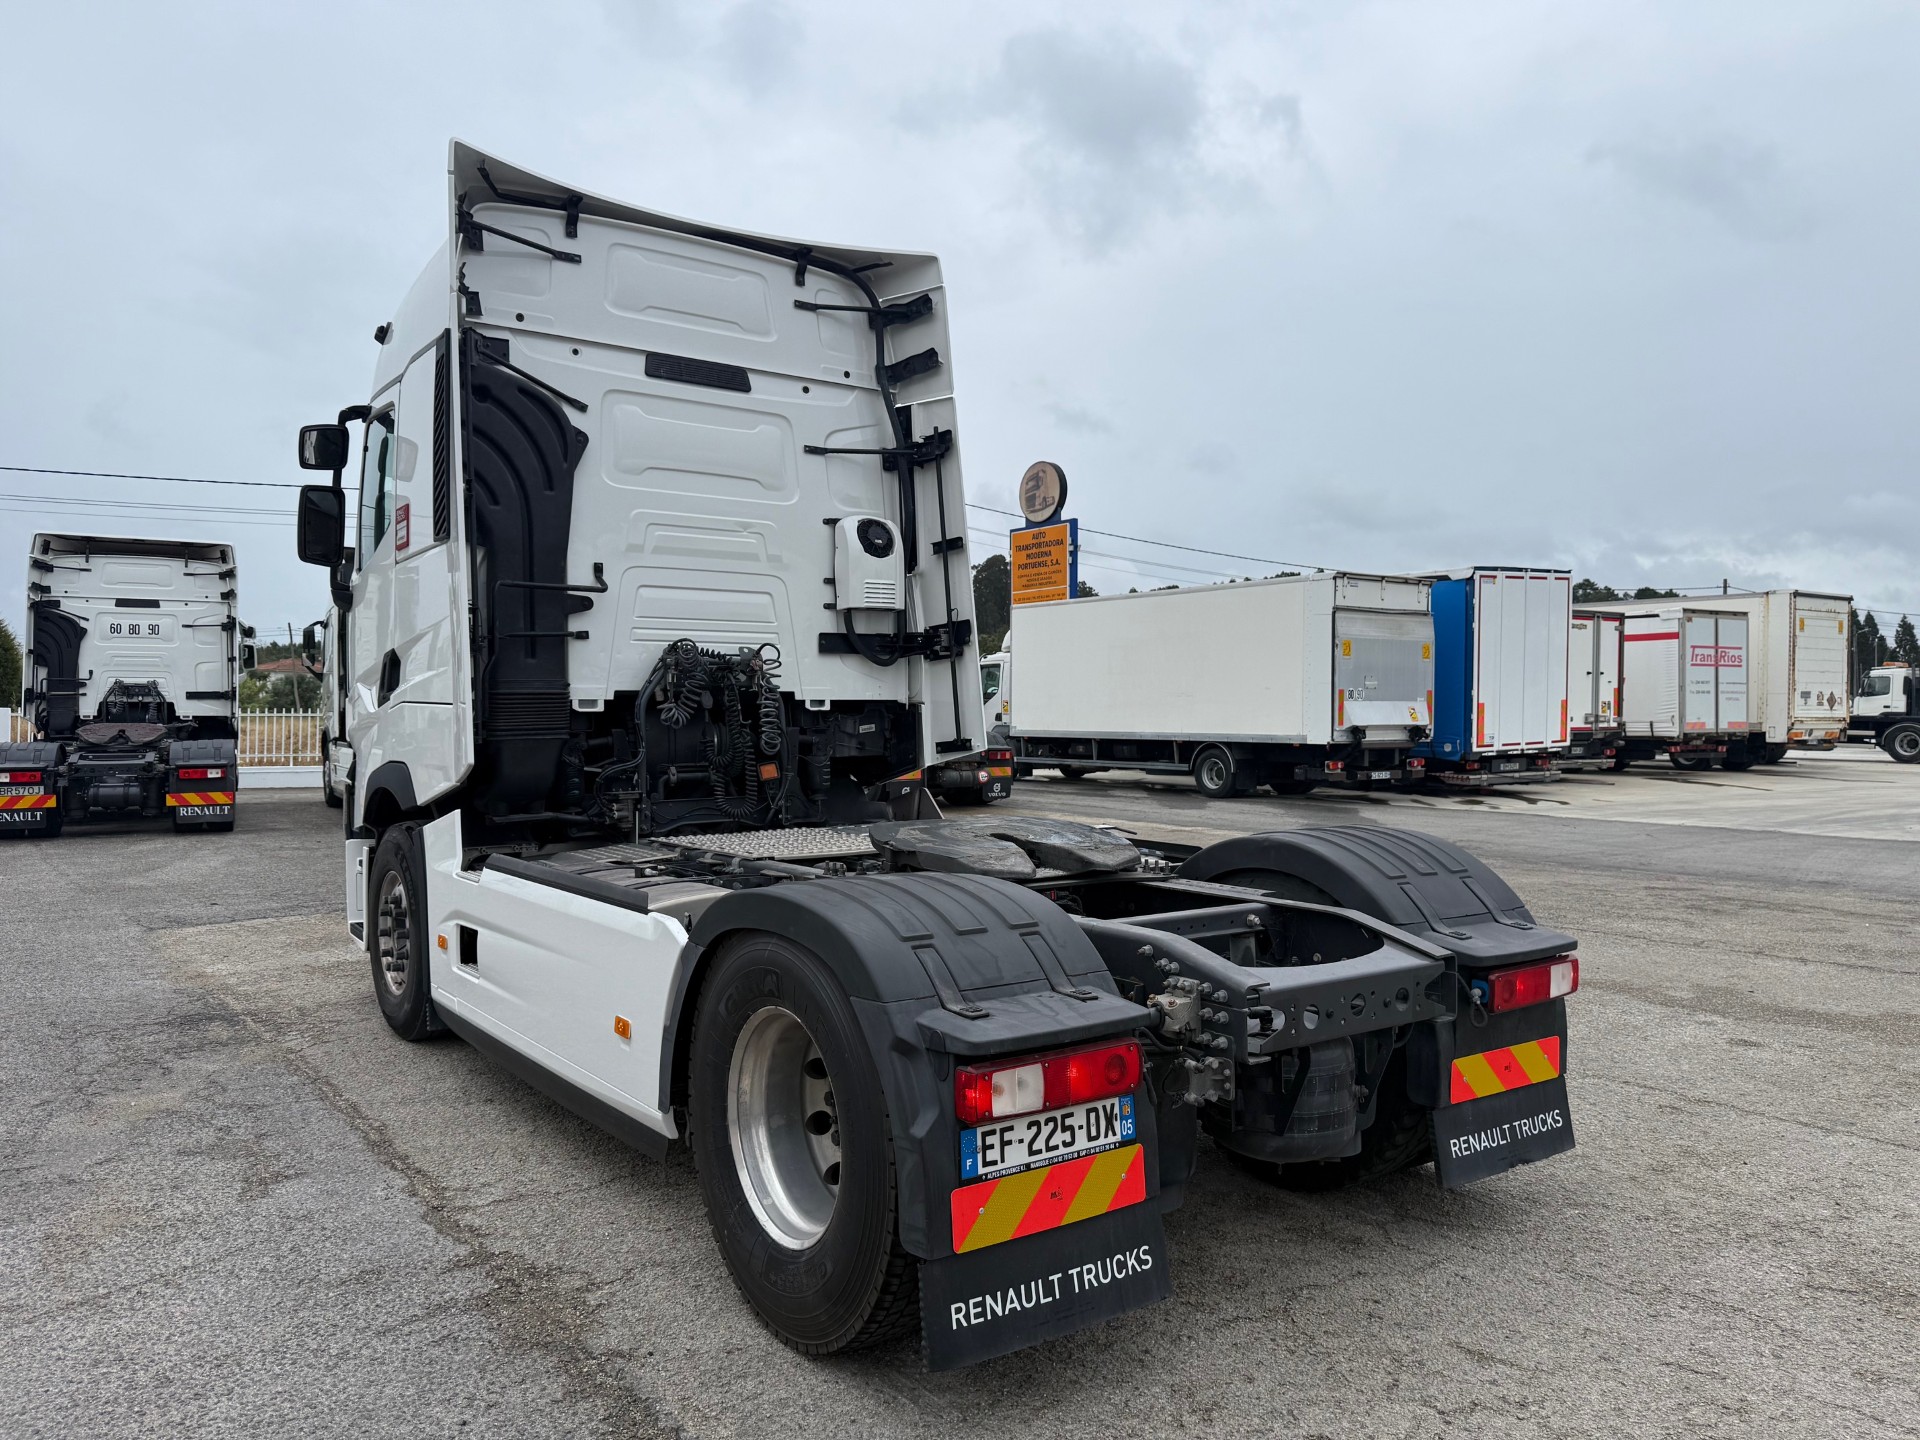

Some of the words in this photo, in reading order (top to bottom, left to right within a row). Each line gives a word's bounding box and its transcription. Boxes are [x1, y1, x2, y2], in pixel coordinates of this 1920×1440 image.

[1032, 532, 1046, 540] AUTO
[1015, 539, 1064, 552] TRANSPORTADORA
[1026, 550, 1052, 560] MODERNA
[1018, 560, 1049, 570] PORTUENSE,
[109, 622, 122, 635] 60
[128, 623, 140, 636] 80
[147, 623, 160, 636] 90
[1348, 689, 1354, 700] 80
[179, 805, 231, 817] RENAULT
[981, 1103, 1118, 1168] EF-225-DX
[1121, 1118, 1133, 1136] 05
[1450, 1123, 1511, 1159] RENAULT
[1512, 1109, 1563, 1140] TRUCKS
[966, 1158, 973, 1171] F
[987, 1171, 1000, 1180] ALPES
[999, 1165, 1021, 1176] PROVENCE
[950, 1271, 1063, 1331] RENAULT
[1067, 1245, 1153, 1293] TRUCKS
